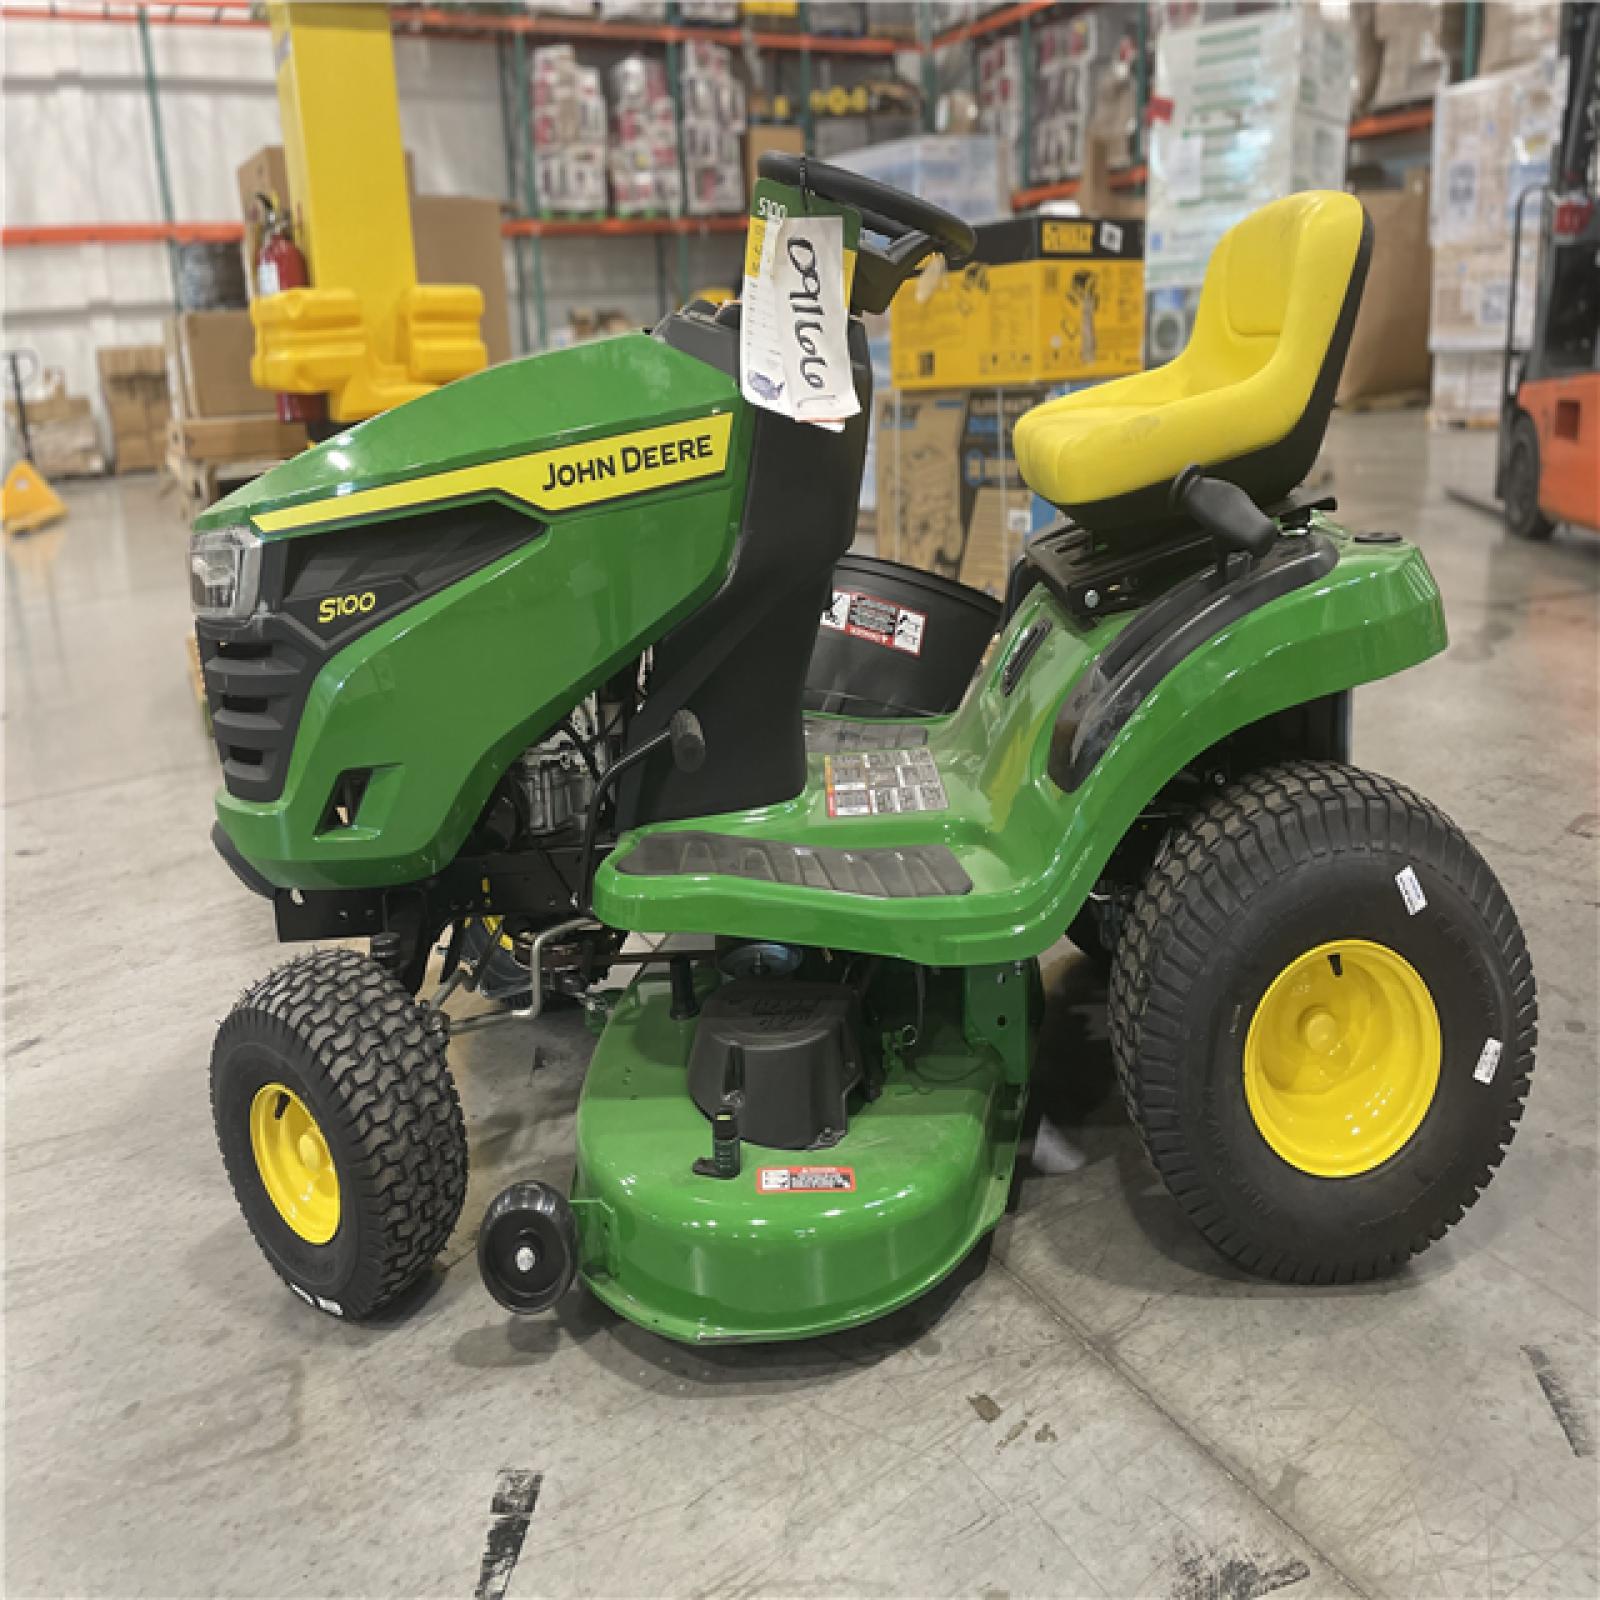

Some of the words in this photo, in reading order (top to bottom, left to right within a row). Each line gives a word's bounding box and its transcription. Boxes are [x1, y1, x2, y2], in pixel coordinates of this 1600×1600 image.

[542, 454, 616, 491] JOHN
[620, 434, 713, 475] DEERE
[317, 591, 376, 623] S100
